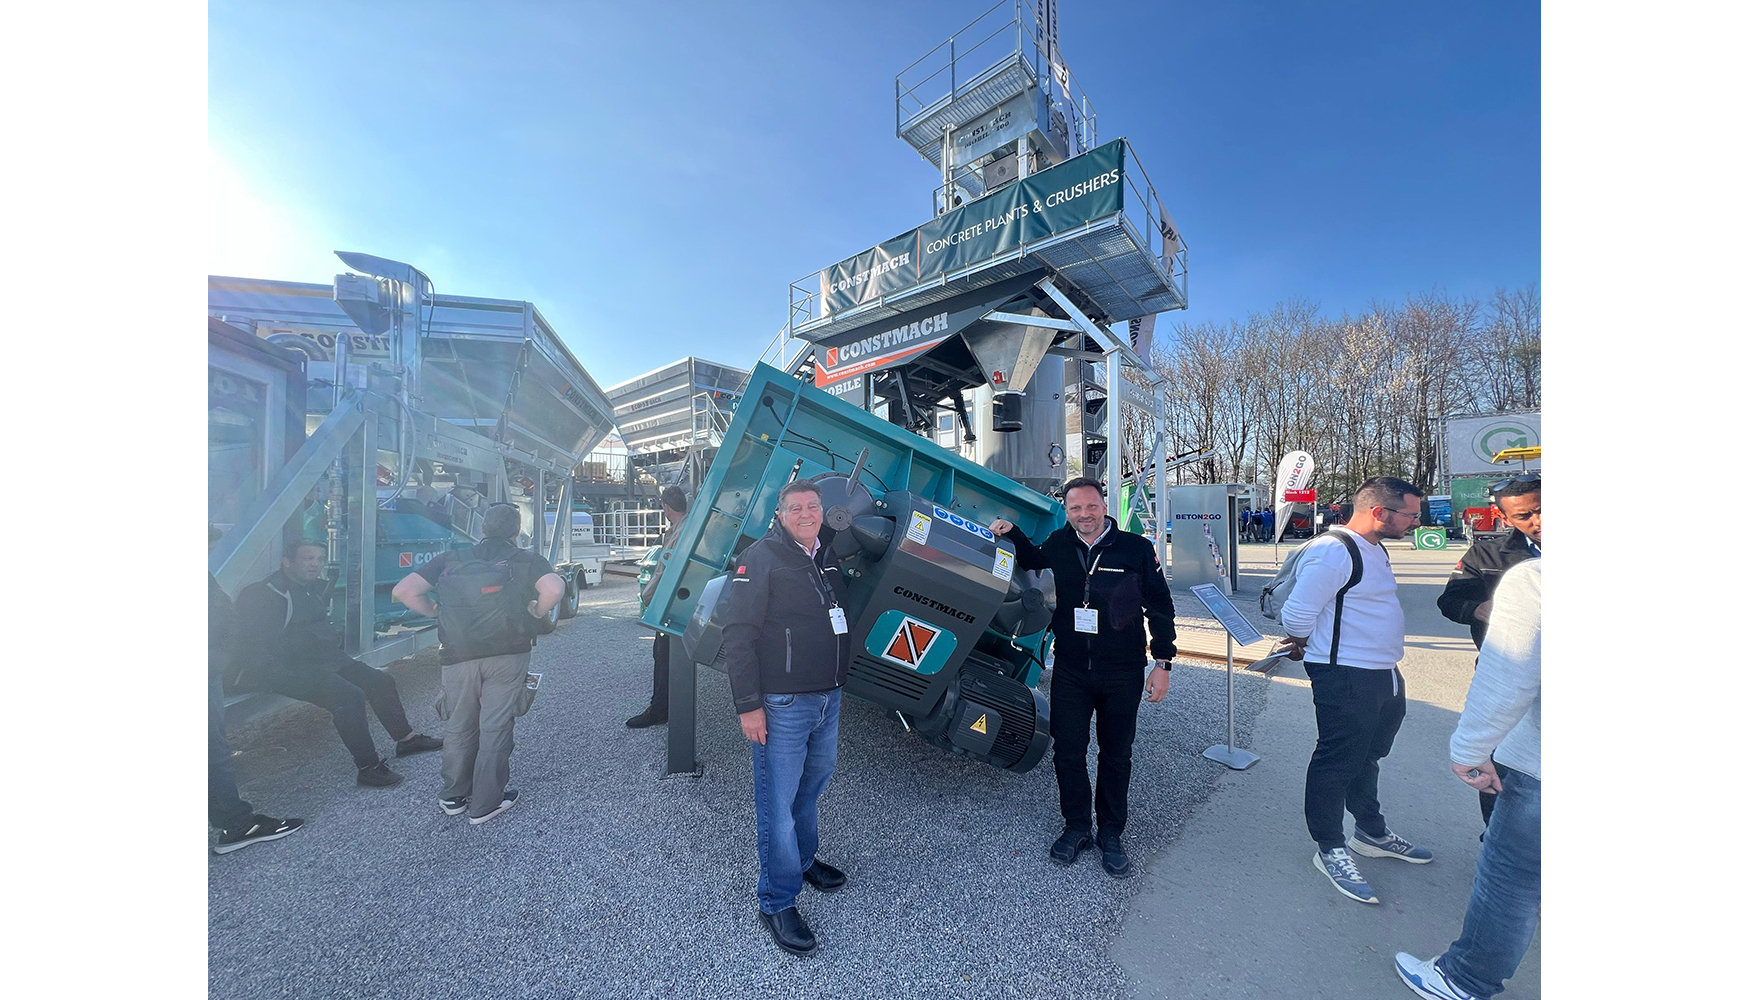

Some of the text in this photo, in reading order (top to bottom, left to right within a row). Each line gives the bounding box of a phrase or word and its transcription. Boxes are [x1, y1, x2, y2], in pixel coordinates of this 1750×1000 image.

[927, 168, 1120, 255] CONCRETE PLANTS & CRUSHERS
[830, 252, 910, 294] CONSTMACH
[839, 312, 949, 361] CONSTMACH
[823, 377, 861, 396] OBILE
[893, 586, 976, 624] CONSTMACH
